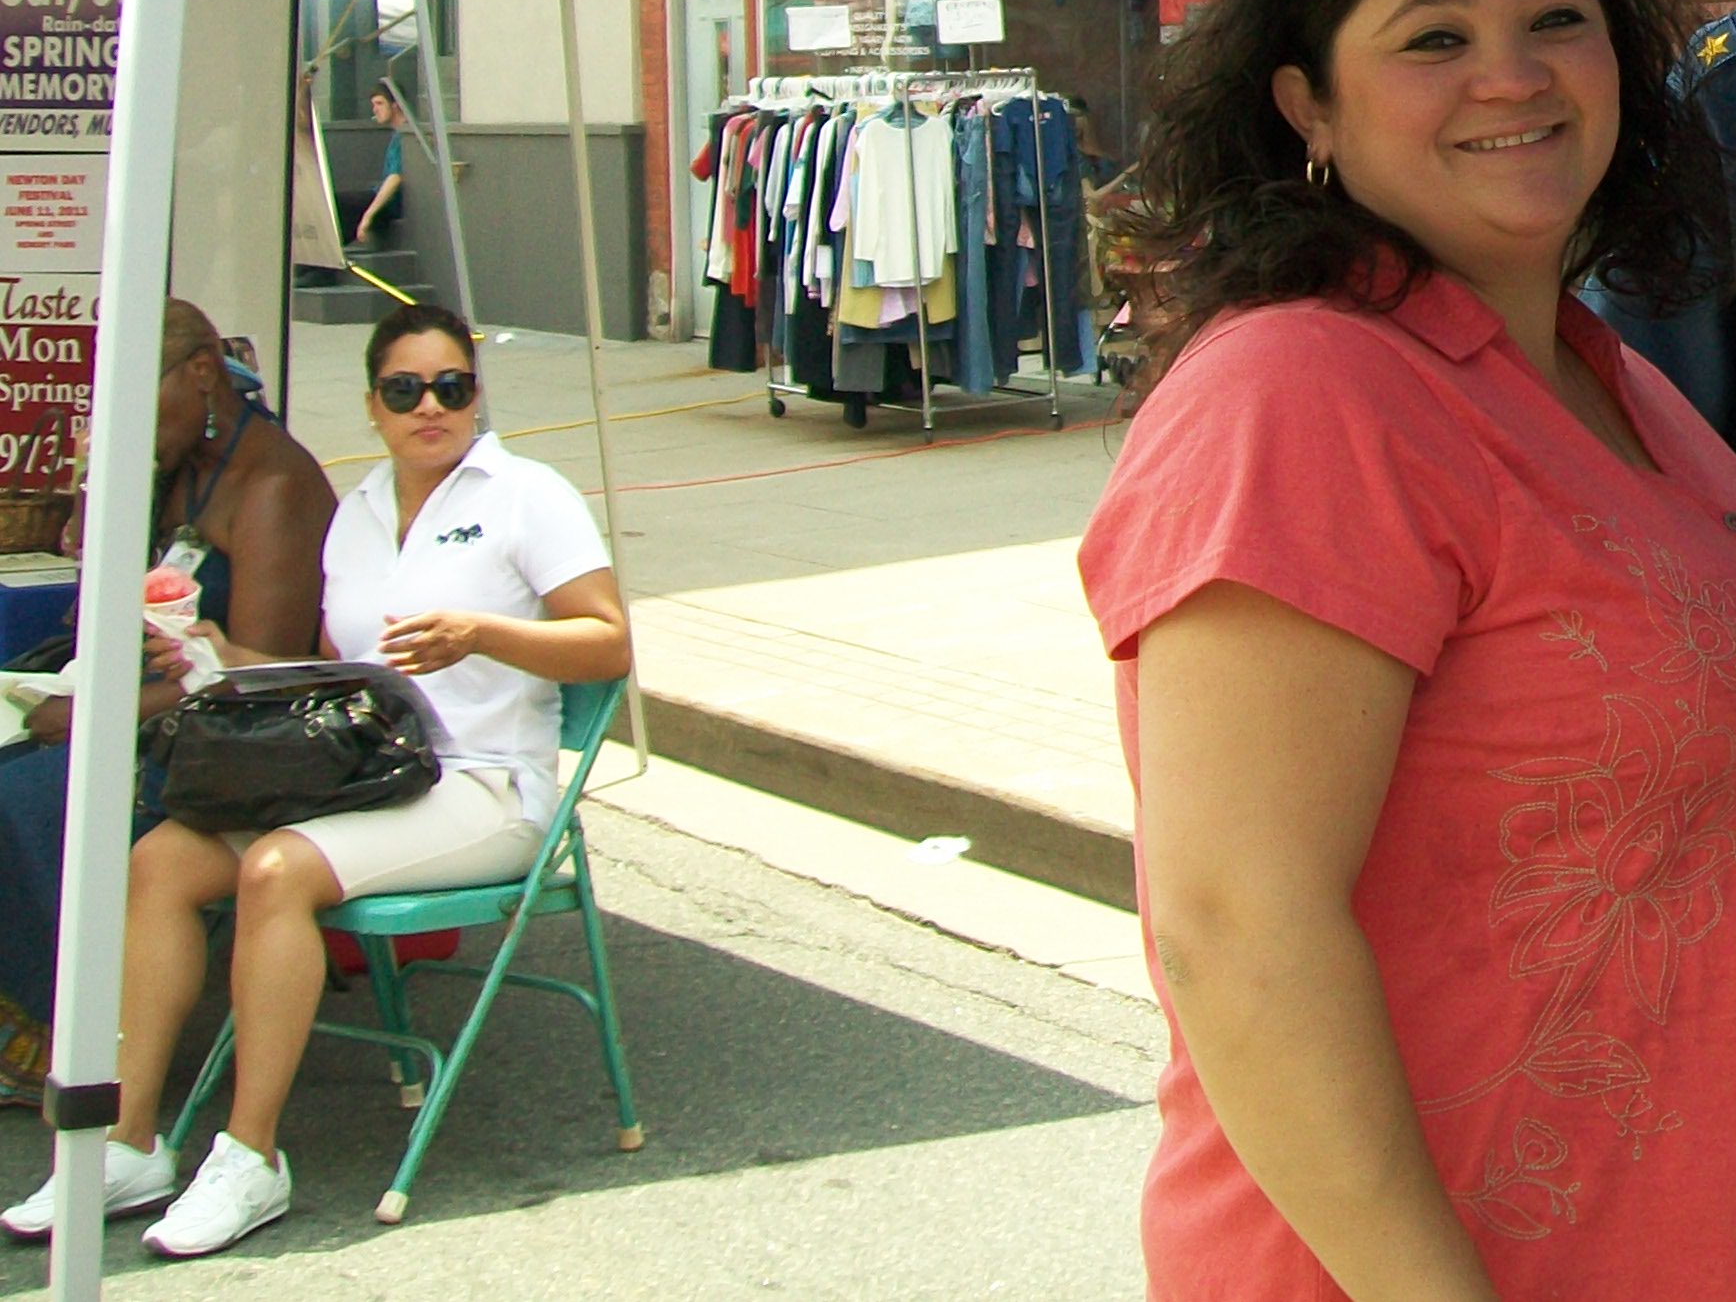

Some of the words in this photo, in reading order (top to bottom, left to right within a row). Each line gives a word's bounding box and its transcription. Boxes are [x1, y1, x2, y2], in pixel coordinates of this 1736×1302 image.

[42, 15, 119, 33] Rain-da
[61, 174, 86, 186] DAY
[0, 277, 82, 321] Taste
[0, 326, 82, 363] Mon
[0, 373, 92, 412] Spring
